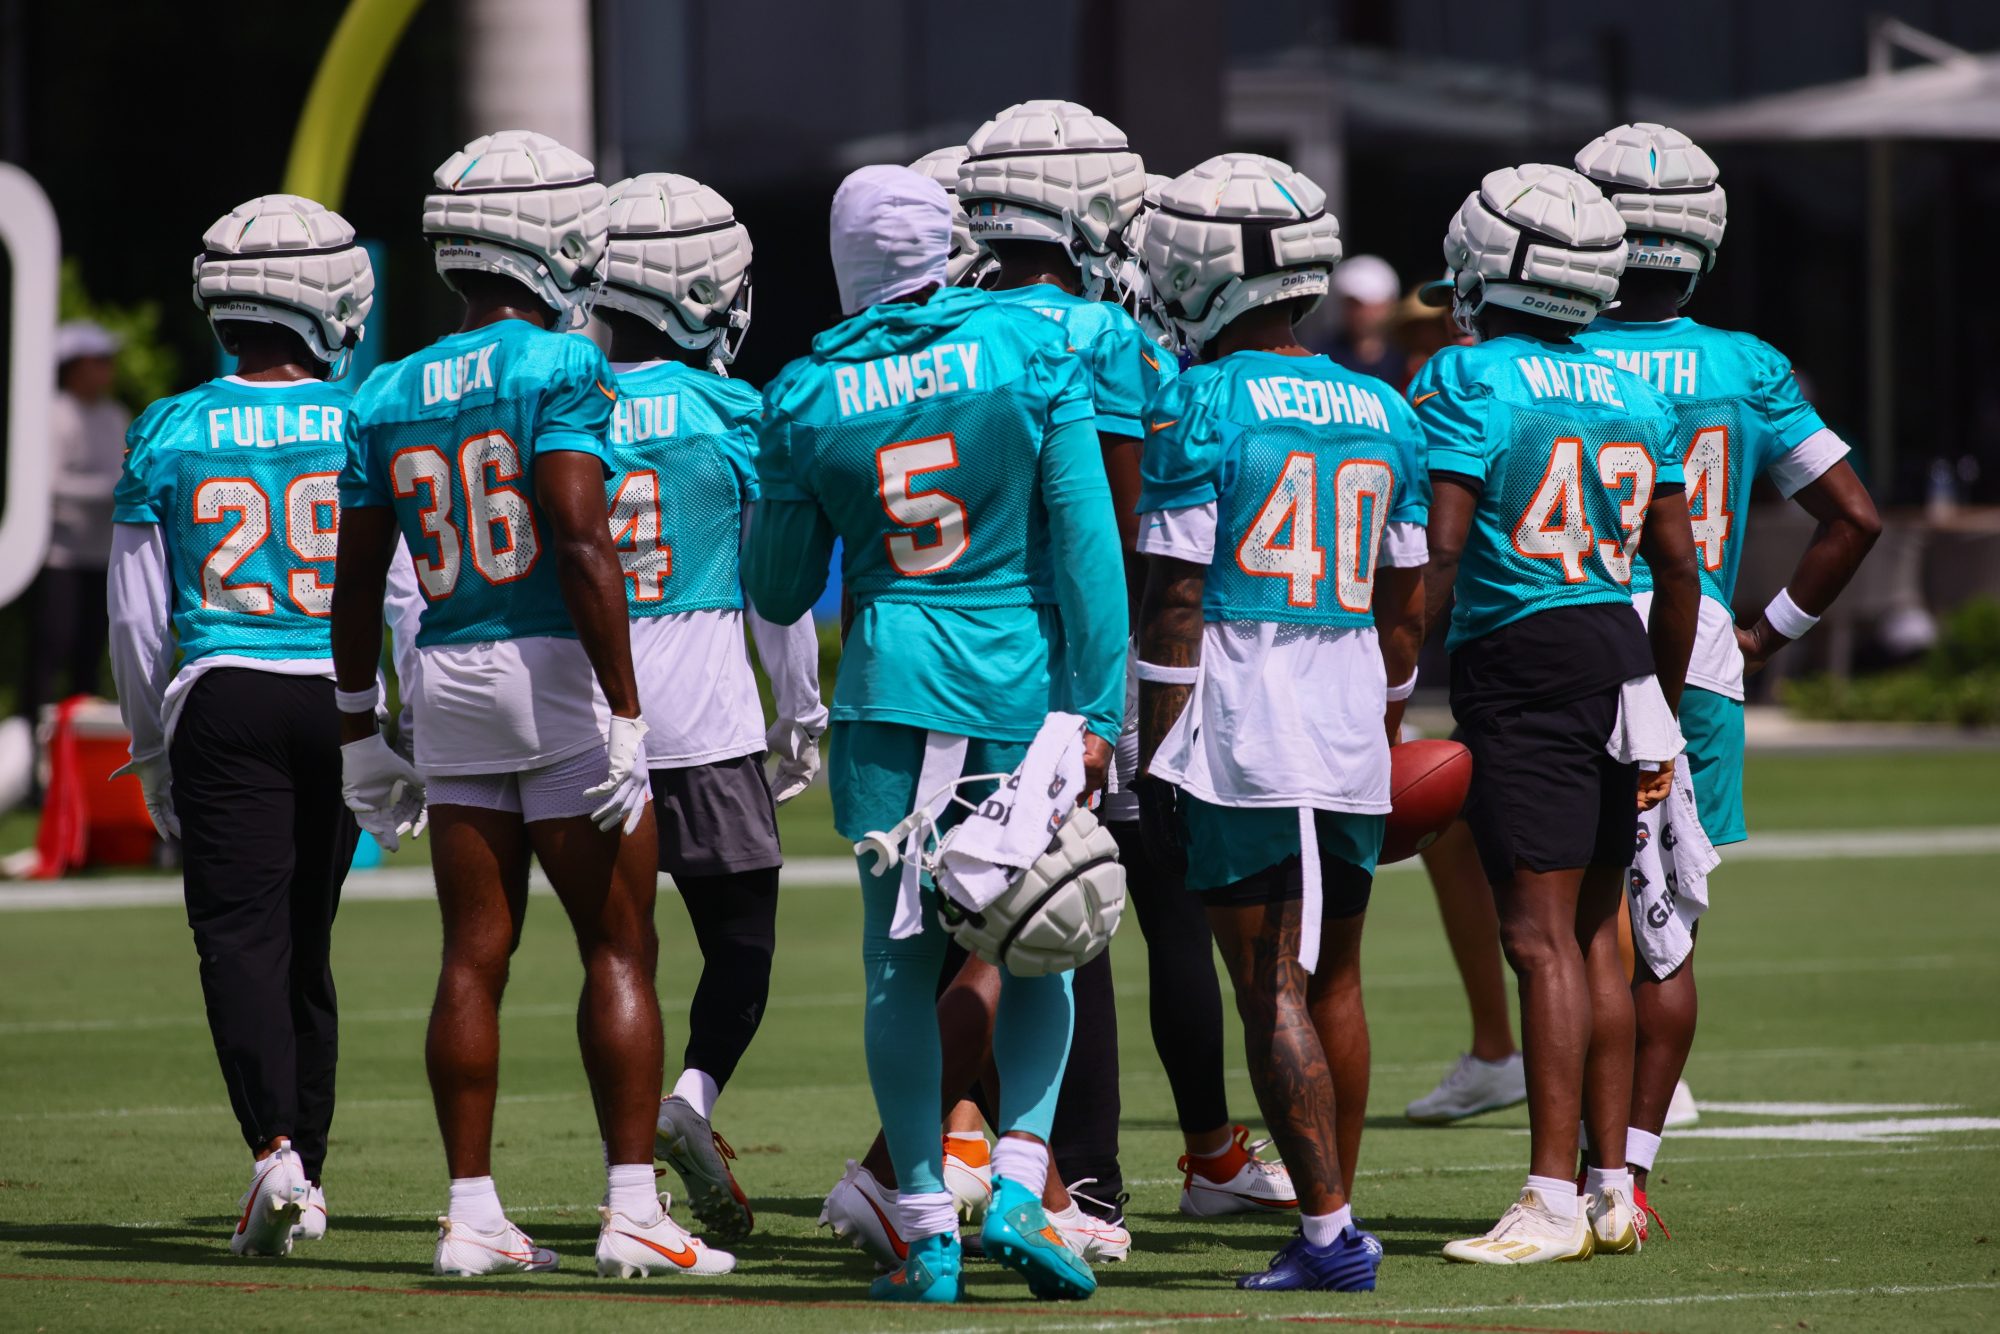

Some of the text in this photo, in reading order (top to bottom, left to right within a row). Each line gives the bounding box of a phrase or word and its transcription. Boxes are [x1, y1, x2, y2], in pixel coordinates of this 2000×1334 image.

[1521, 295, 1587, 318] Dolphins
[1594, 350, 1696, 394] MITH
[208, 405, 342, 448] FULLER
[423, 342, 497, 405] DUCK
[835, 342, 979, 416] RAMSEY
[1246, 376, 1390, 433] NEEDHAM
[192, 470, 342, 617] 29
[390, 429, 542, 600] 36
[608, 469, 672, 601] 4
[875, 432, 970, 576] 5
[1235, 451, 1394, 613] 40
[1511, 437, 1656, 584] 43
[1683, 425, 1734, 571] 4
